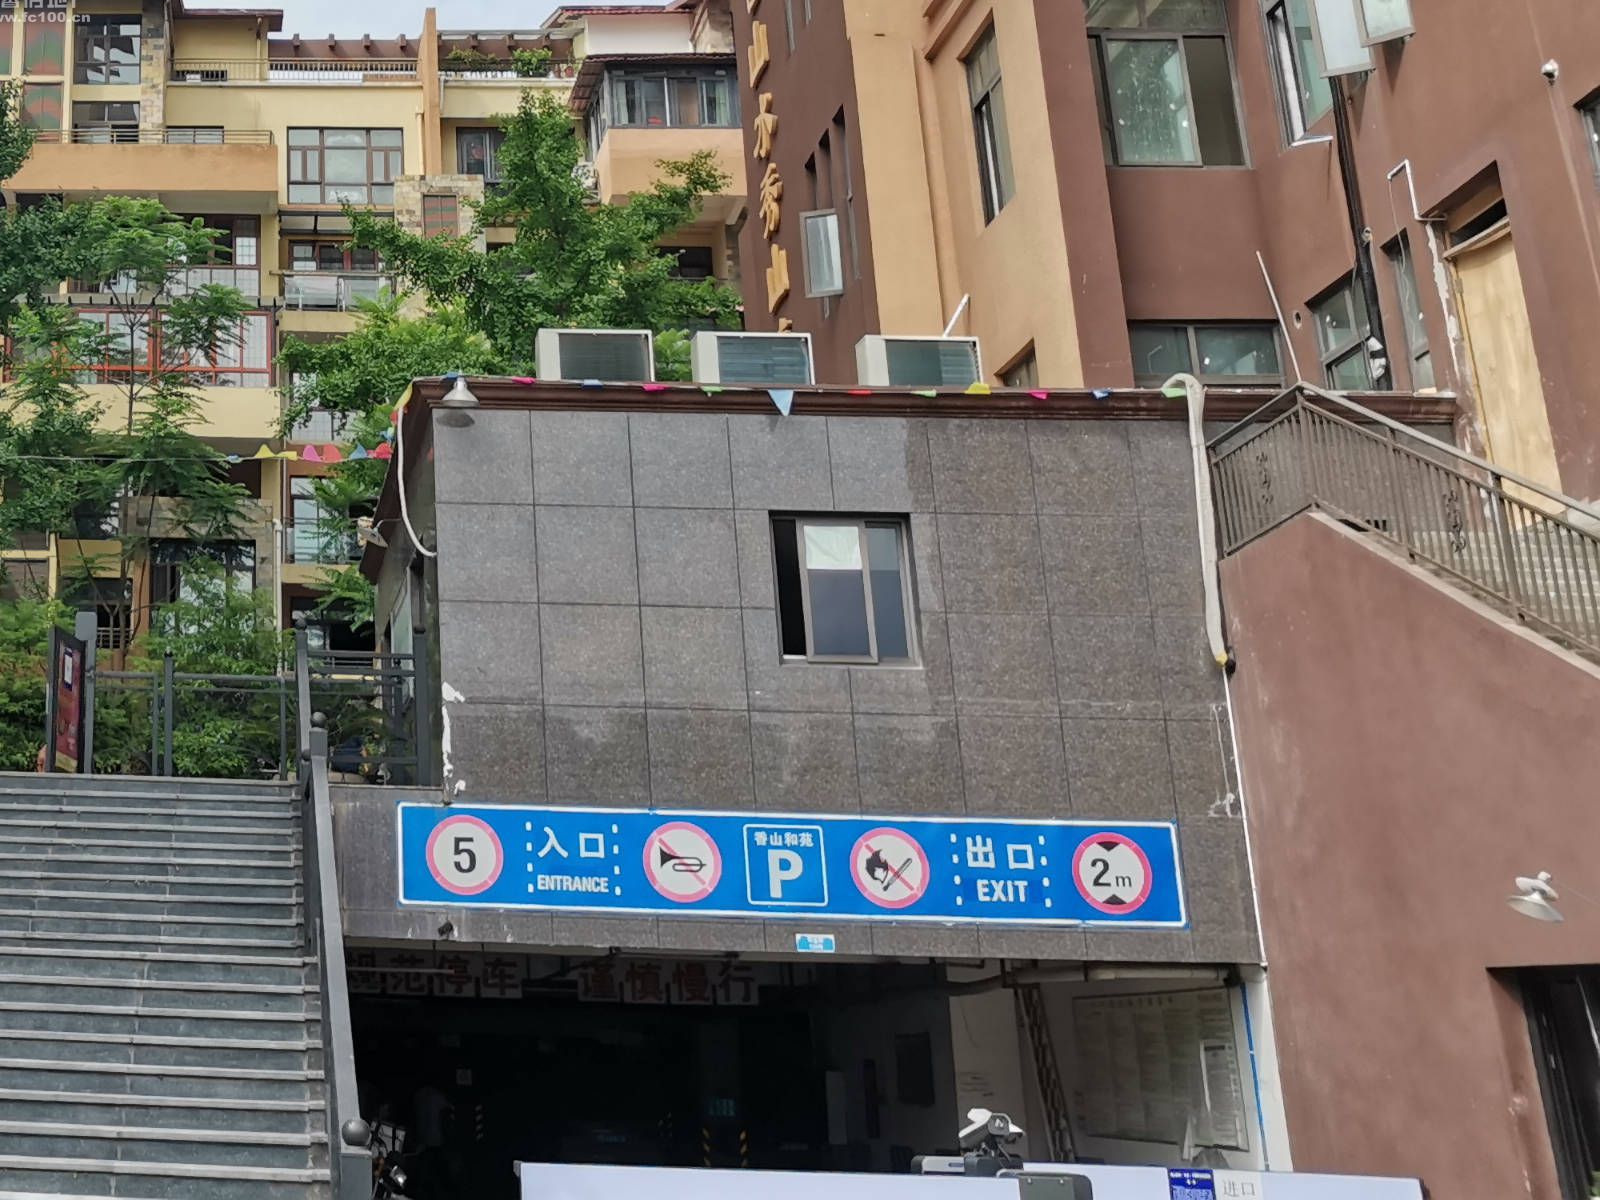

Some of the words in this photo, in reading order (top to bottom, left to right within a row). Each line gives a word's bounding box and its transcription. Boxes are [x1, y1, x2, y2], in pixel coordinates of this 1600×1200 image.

[453, 836, 477, 873] 5
[537, 826, 606, 859] 入口
[753, 831, 815, 848] 香山和苑
[965, 834, 1036, 870] 出口
[537, 874, 609, 894] ENTRANCE
[767, 849, 804, 899] P
[977, 878, 1029, 903] EXIT
